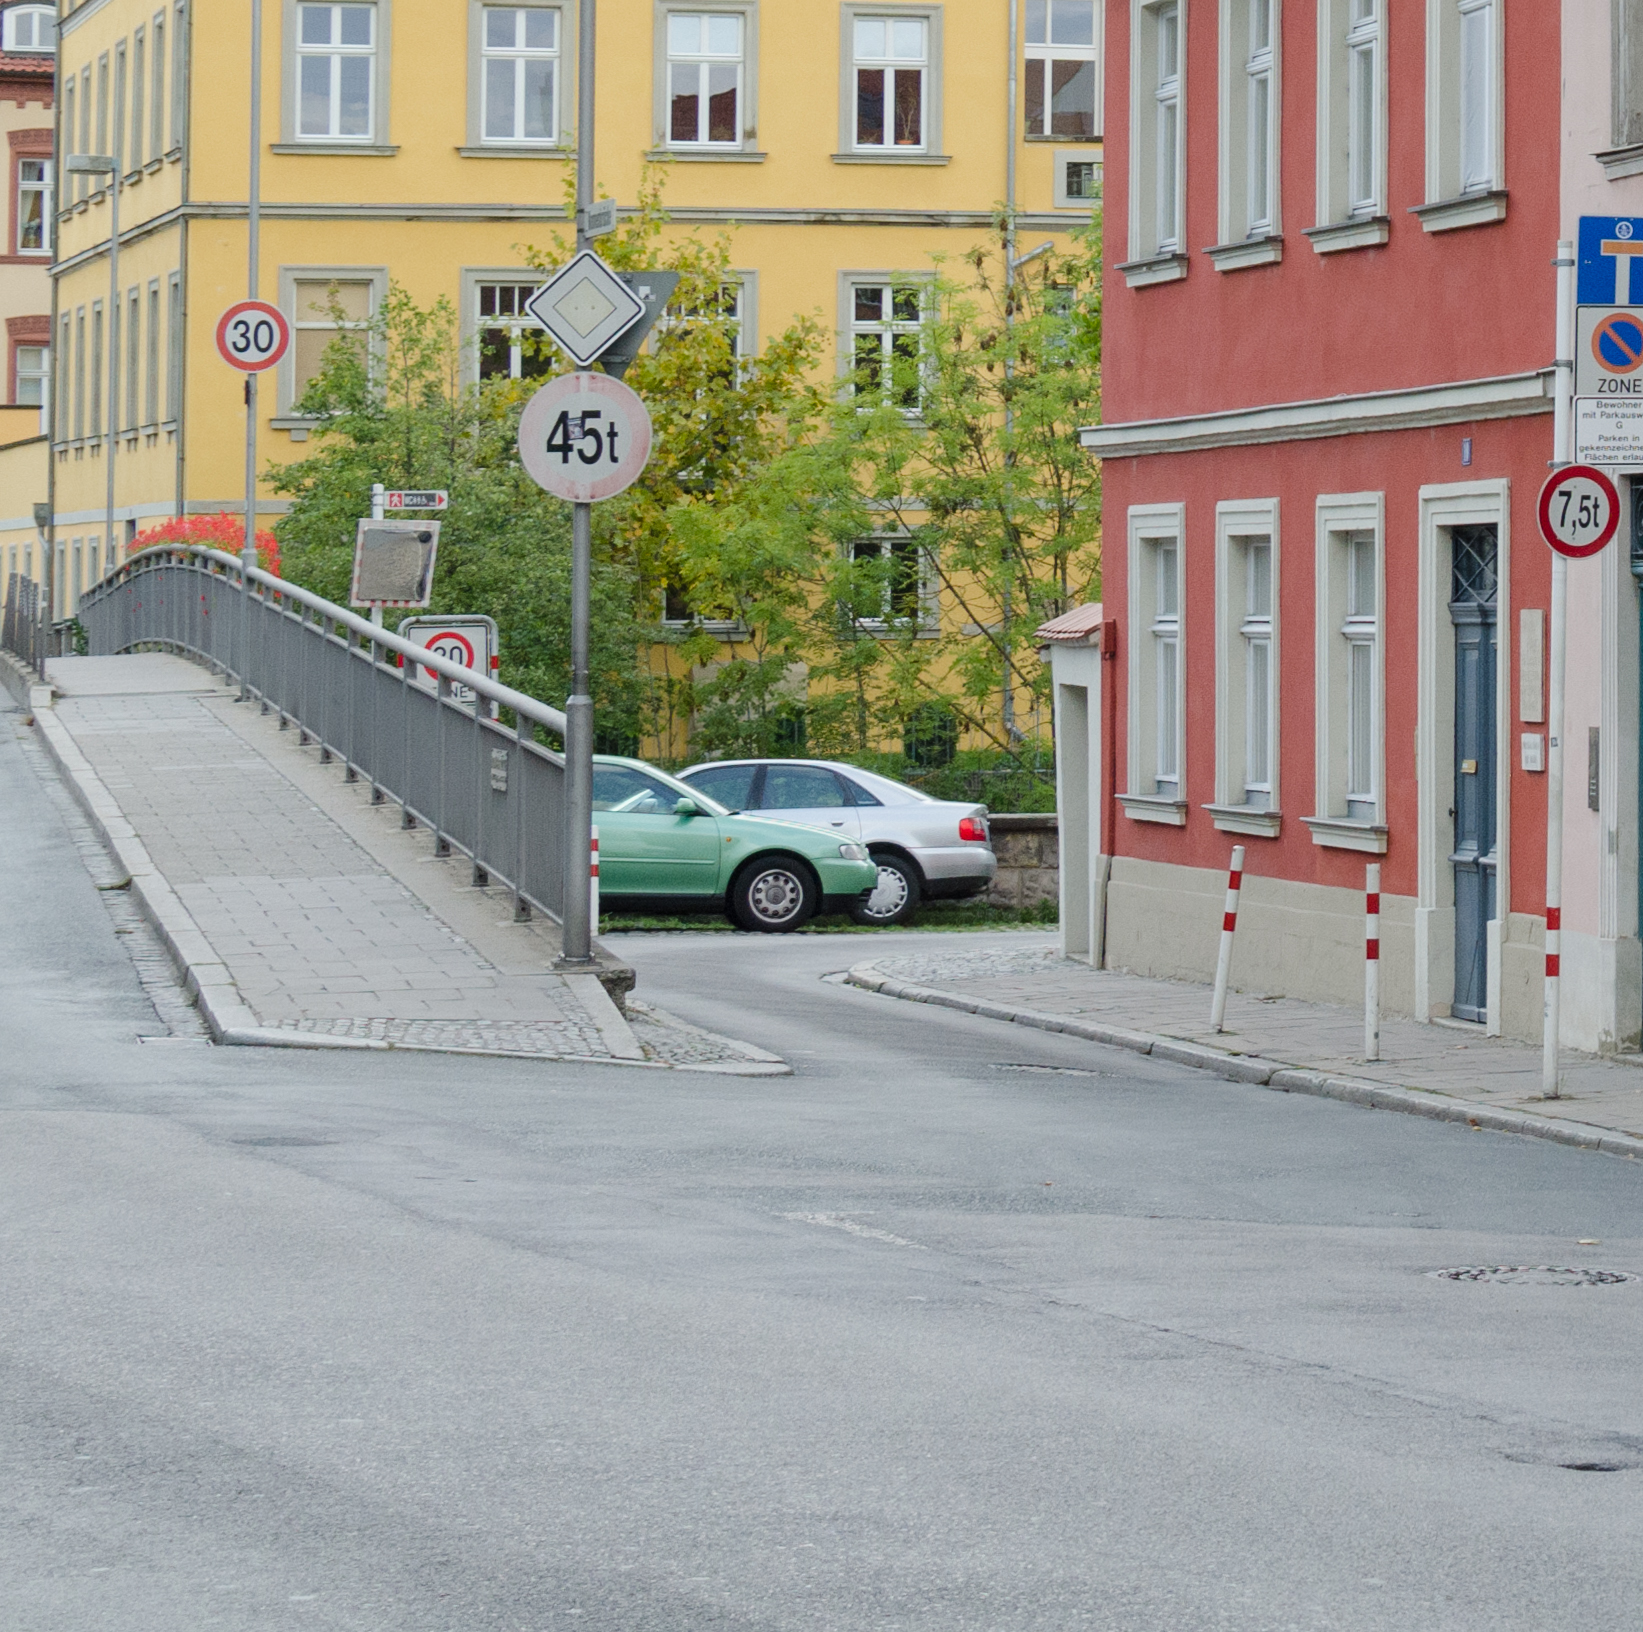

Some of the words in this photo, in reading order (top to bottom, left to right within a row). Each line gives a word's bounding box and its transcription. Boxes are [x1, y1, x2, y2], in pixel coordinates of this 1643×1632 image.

[231, 319, 274, 353] 30
[1597, 378, 1643, 393] ZONE
[1596, 400, 1642, 409] Bewohner
[1582, 410, 1597, 419] mit
[1615, 420, 1624, 429] G
[1598, 434, 1629, 442] Parken
[1632, 434, 1640, 442] in
[1584, 453, 1619, 461] Flächen
[1558, 490, 1600, 536] 7,5t
